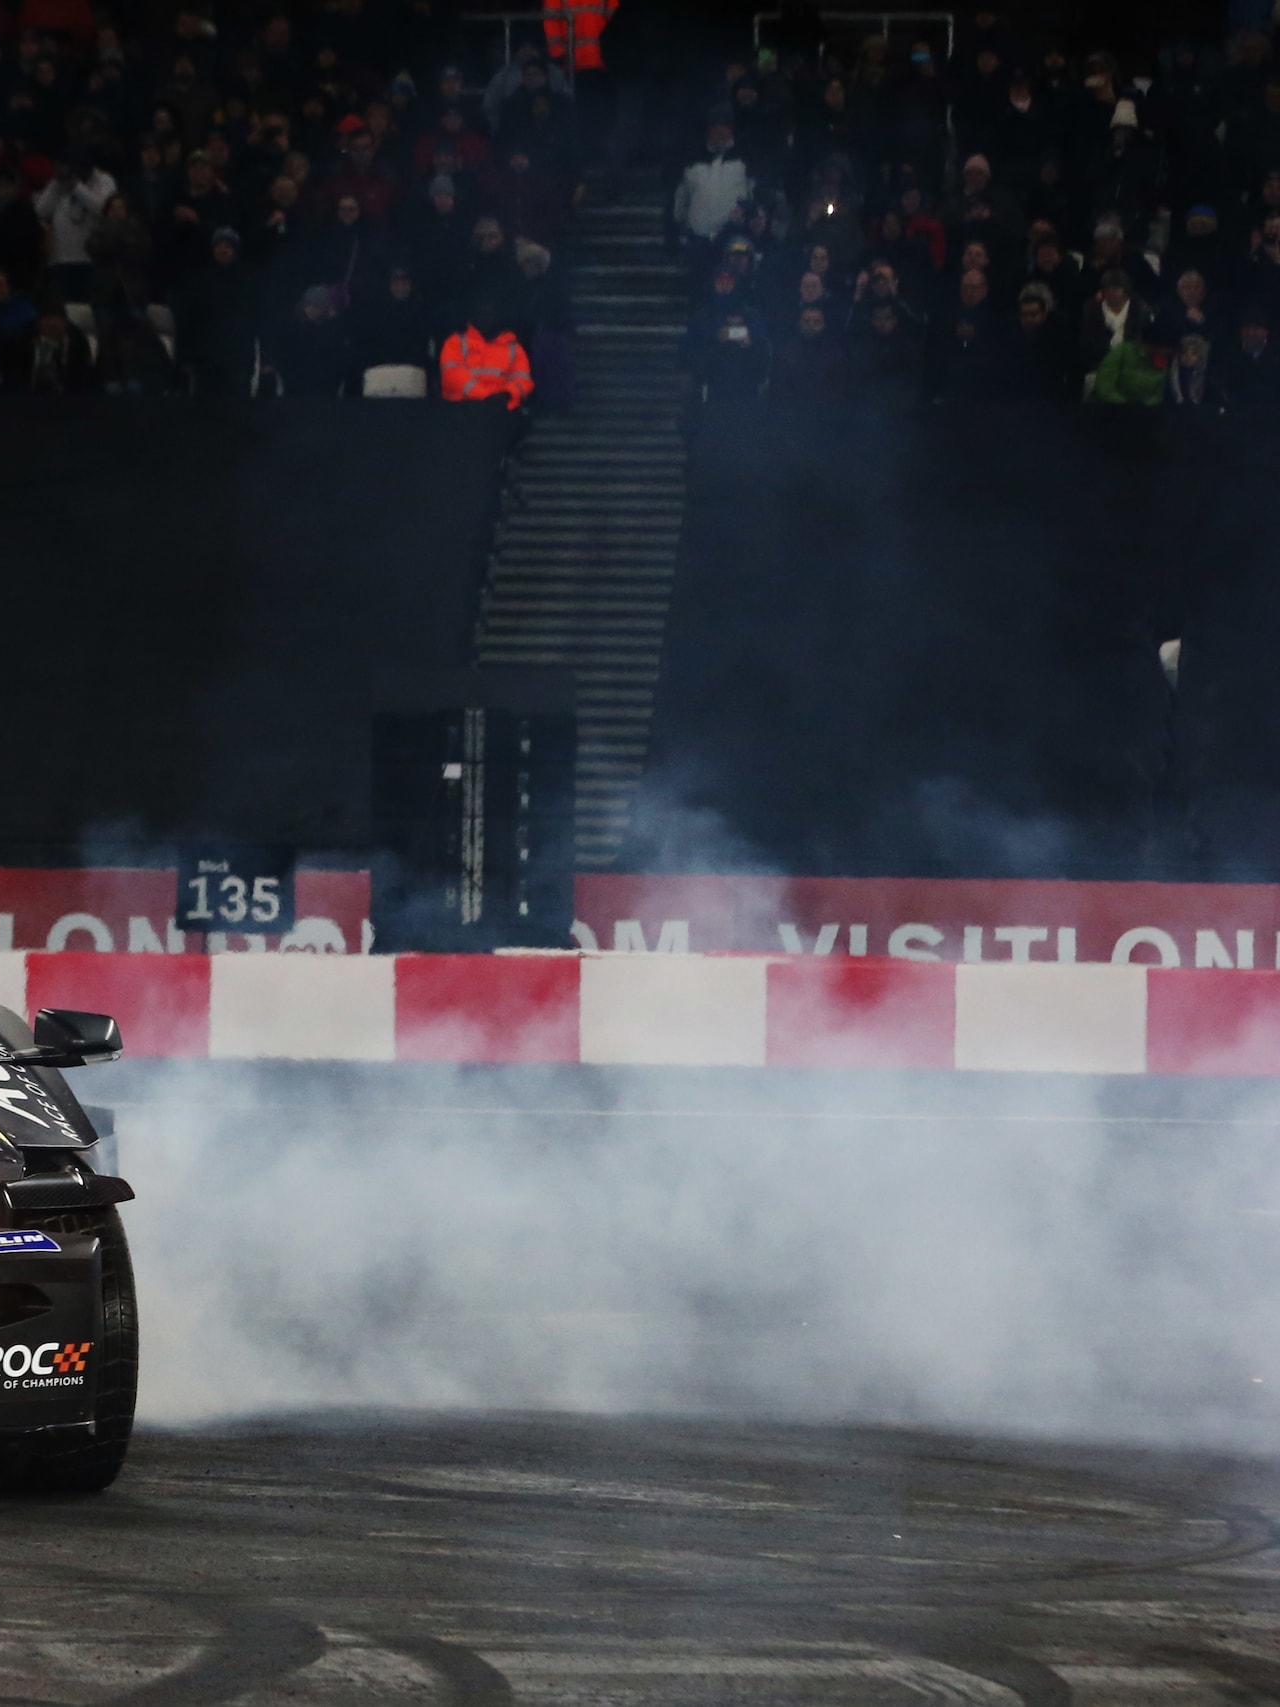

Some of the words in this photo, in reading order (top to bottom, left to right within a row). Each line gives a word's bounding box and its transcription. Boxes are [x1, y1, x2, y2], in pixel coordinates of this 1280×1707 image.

[197, 859, 230, 873] Block
[186, 876, 281, 923] 135
[777, 923, 1280, 968] VISITON
[17, 1074, 46, 1097] OF
[36, 1097, 82, 1143] RACE
[3, 1379, 19, 1389] OF
[22, 1375, 84, 1389] CHAMPIONS
